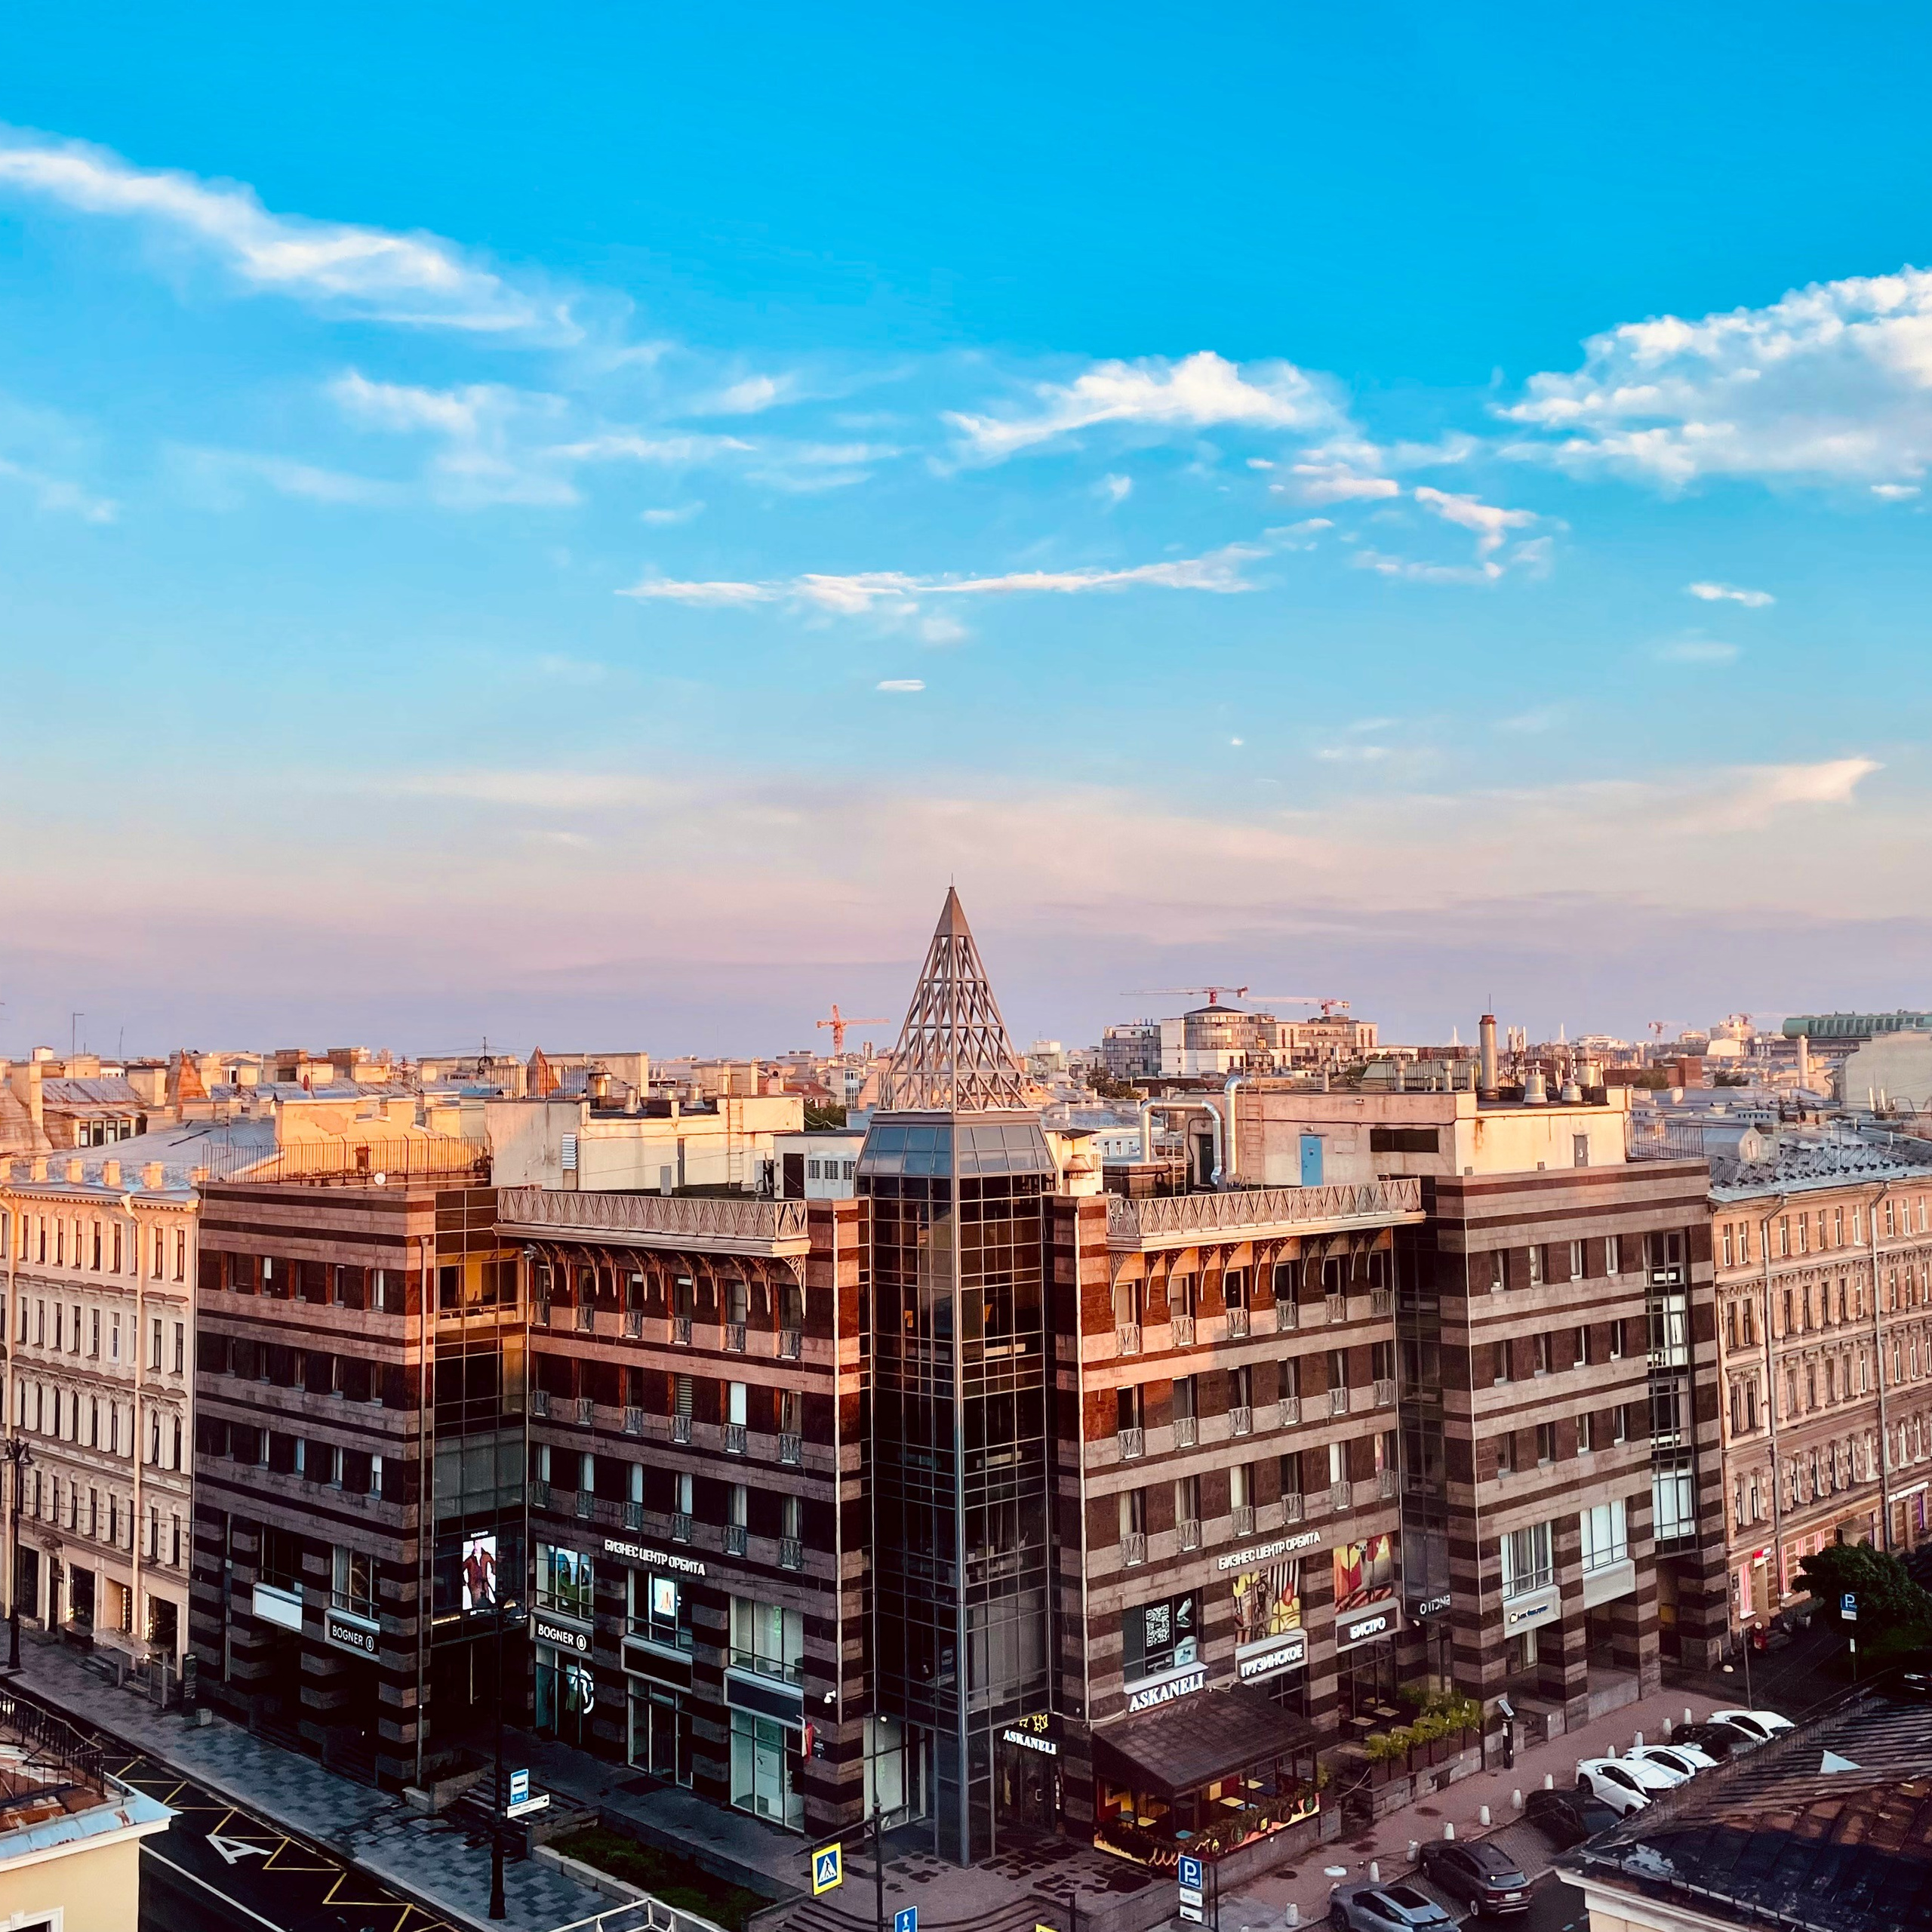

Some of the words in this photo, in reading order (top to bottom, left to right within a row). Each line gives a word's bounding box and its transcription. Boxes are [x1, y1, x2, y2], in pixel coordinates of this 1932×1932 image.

[605, 1539, 638, 1558] БИЗНЕС
[638, 1547, 668, 1565] ЦЕНТР
[668, 1555, 706, 1576] ОРБИТА
[1217, 1549, 1256, 1571] БИЗНЕС
[1256, 1541, 1285, 1560] ЦЕНТР
[1285, 1531, 1321, 1551] ОРБИТА
[1844, 1593, 1856, 1608] P
[332, 1625, 364, 1646] BOGNER
[538, 1623, 574, 1646] BOGNER
[1349, 1617, 1386, 1640] БИСТРО
[1240, 1644, 1303, 1678] ГРУЗИНСКОЕ
[1128, 1672, 1204, 1713] ASKANELI
[1002, 1729, 1057, 1755] ASKANELI
[1184, 1860, 1198, 1883] P
